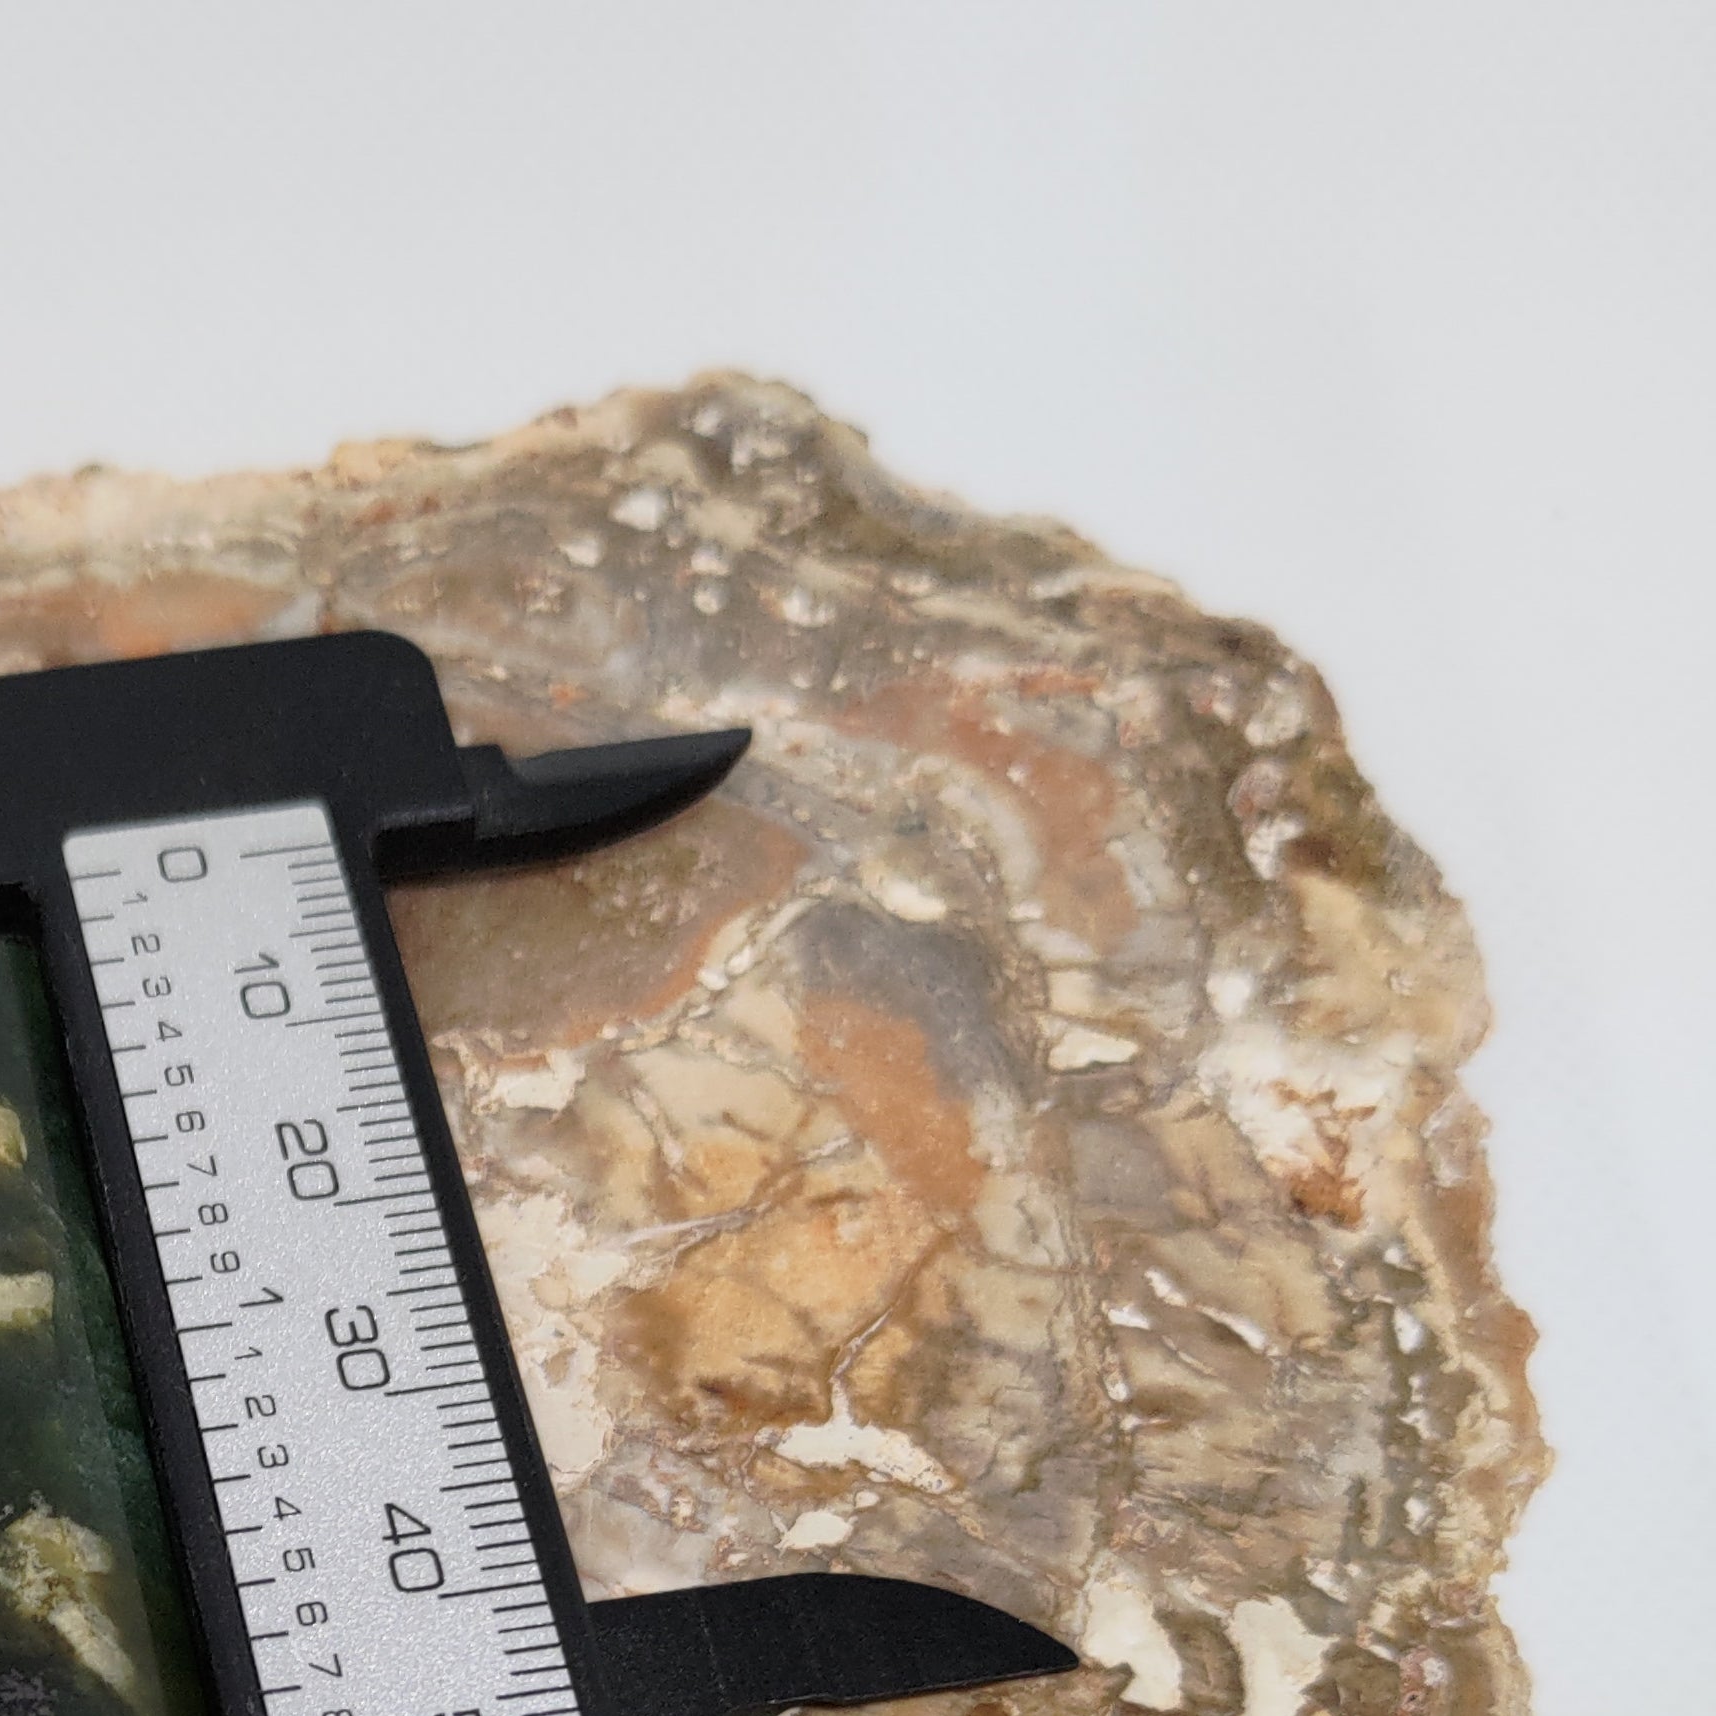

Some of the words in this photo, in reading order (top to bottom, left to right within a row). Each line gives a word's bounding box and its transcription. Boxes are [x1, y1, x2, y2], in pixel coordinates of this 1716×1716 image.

[123, 892, 148, 904] 1
[131, 934, 160, 955] 2
[142, 976, 171, 997] 3
[158, 1021, 182, 1042] 4
[164, 1064, 194, 1086] 5
[176, 1111, 205, 1132] 6
[187, 1155, 217, 1177] 7
[157, 846, 208, 883] 0
[235, 953, 291, 1019] 10
[275, 1119, 339, 1201] 20
[325, 1305, 391, 1391] 30
[382, 1503, 445, 1593] 40
[198, 1203, 229, 1225] 8
[210, 1251, 240, 1273] 9
[239, 1287, 284, 1308] 1
[235, 1347, 262, 1360] 1
[245, 1395, 276, 1419] 2
[257, 1444, 289, 1469] 3
[274, 1497, 302, 1521] 4
[283, 1548, 315, 1572] 5
[296, 1601, 328, 1626] 6
[309, 1654, 343, 1678] 7
